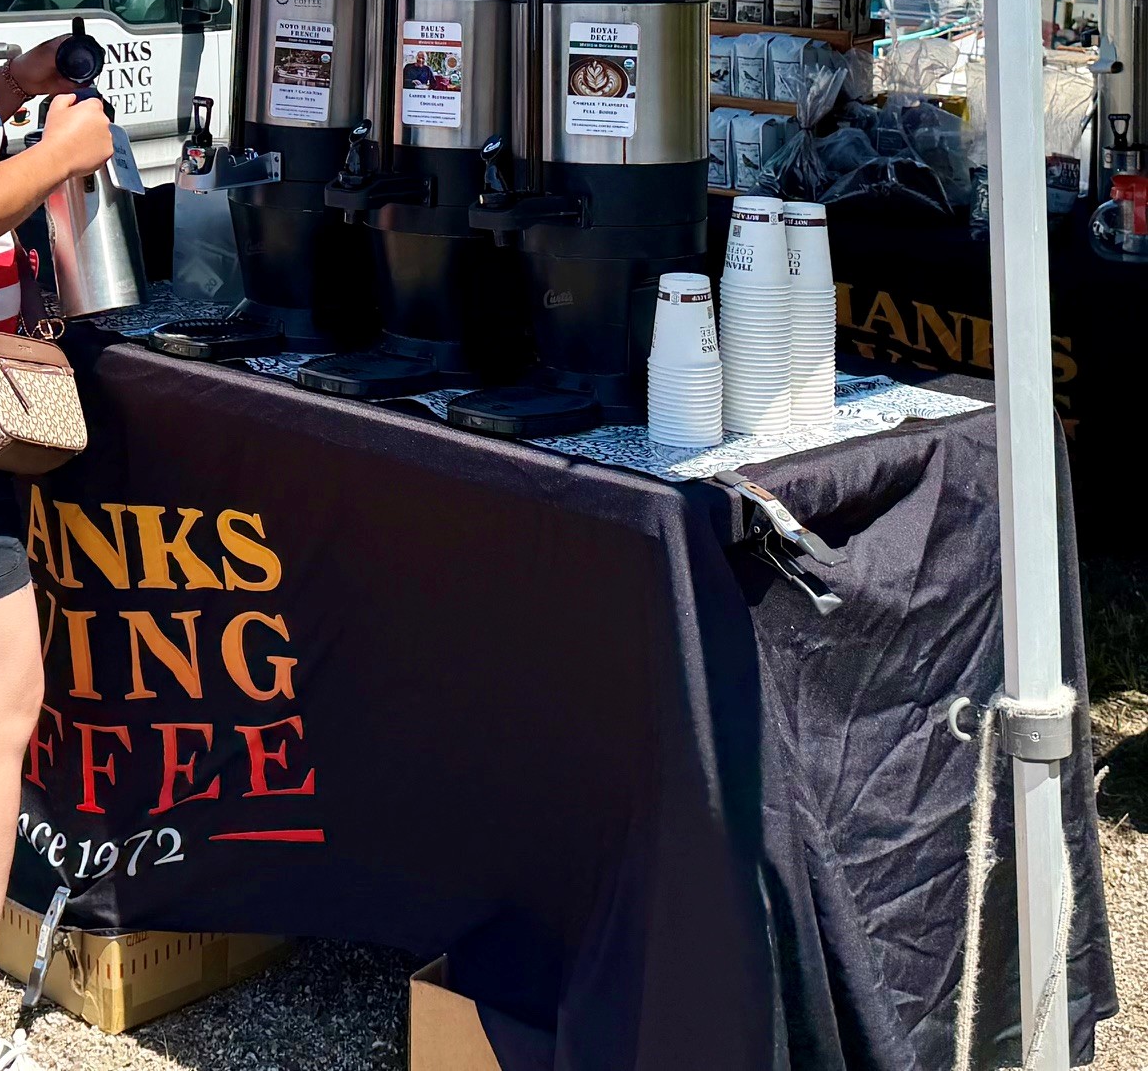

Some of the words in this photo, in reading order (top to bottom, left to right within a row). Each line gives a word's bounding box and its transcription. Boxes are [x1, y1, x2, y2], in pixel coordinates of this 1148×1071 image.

[420, 25, 445, 33] PAUL'S
[590, 26, 619, 34] ROYAL
[103, 40, 153, 65] NKS
[100, 65, 153, 90] ING
[205, 279, 218, 292] 20
[27, 483, 282, 592] ANKS
[74, 827, 185, 879] 1972
